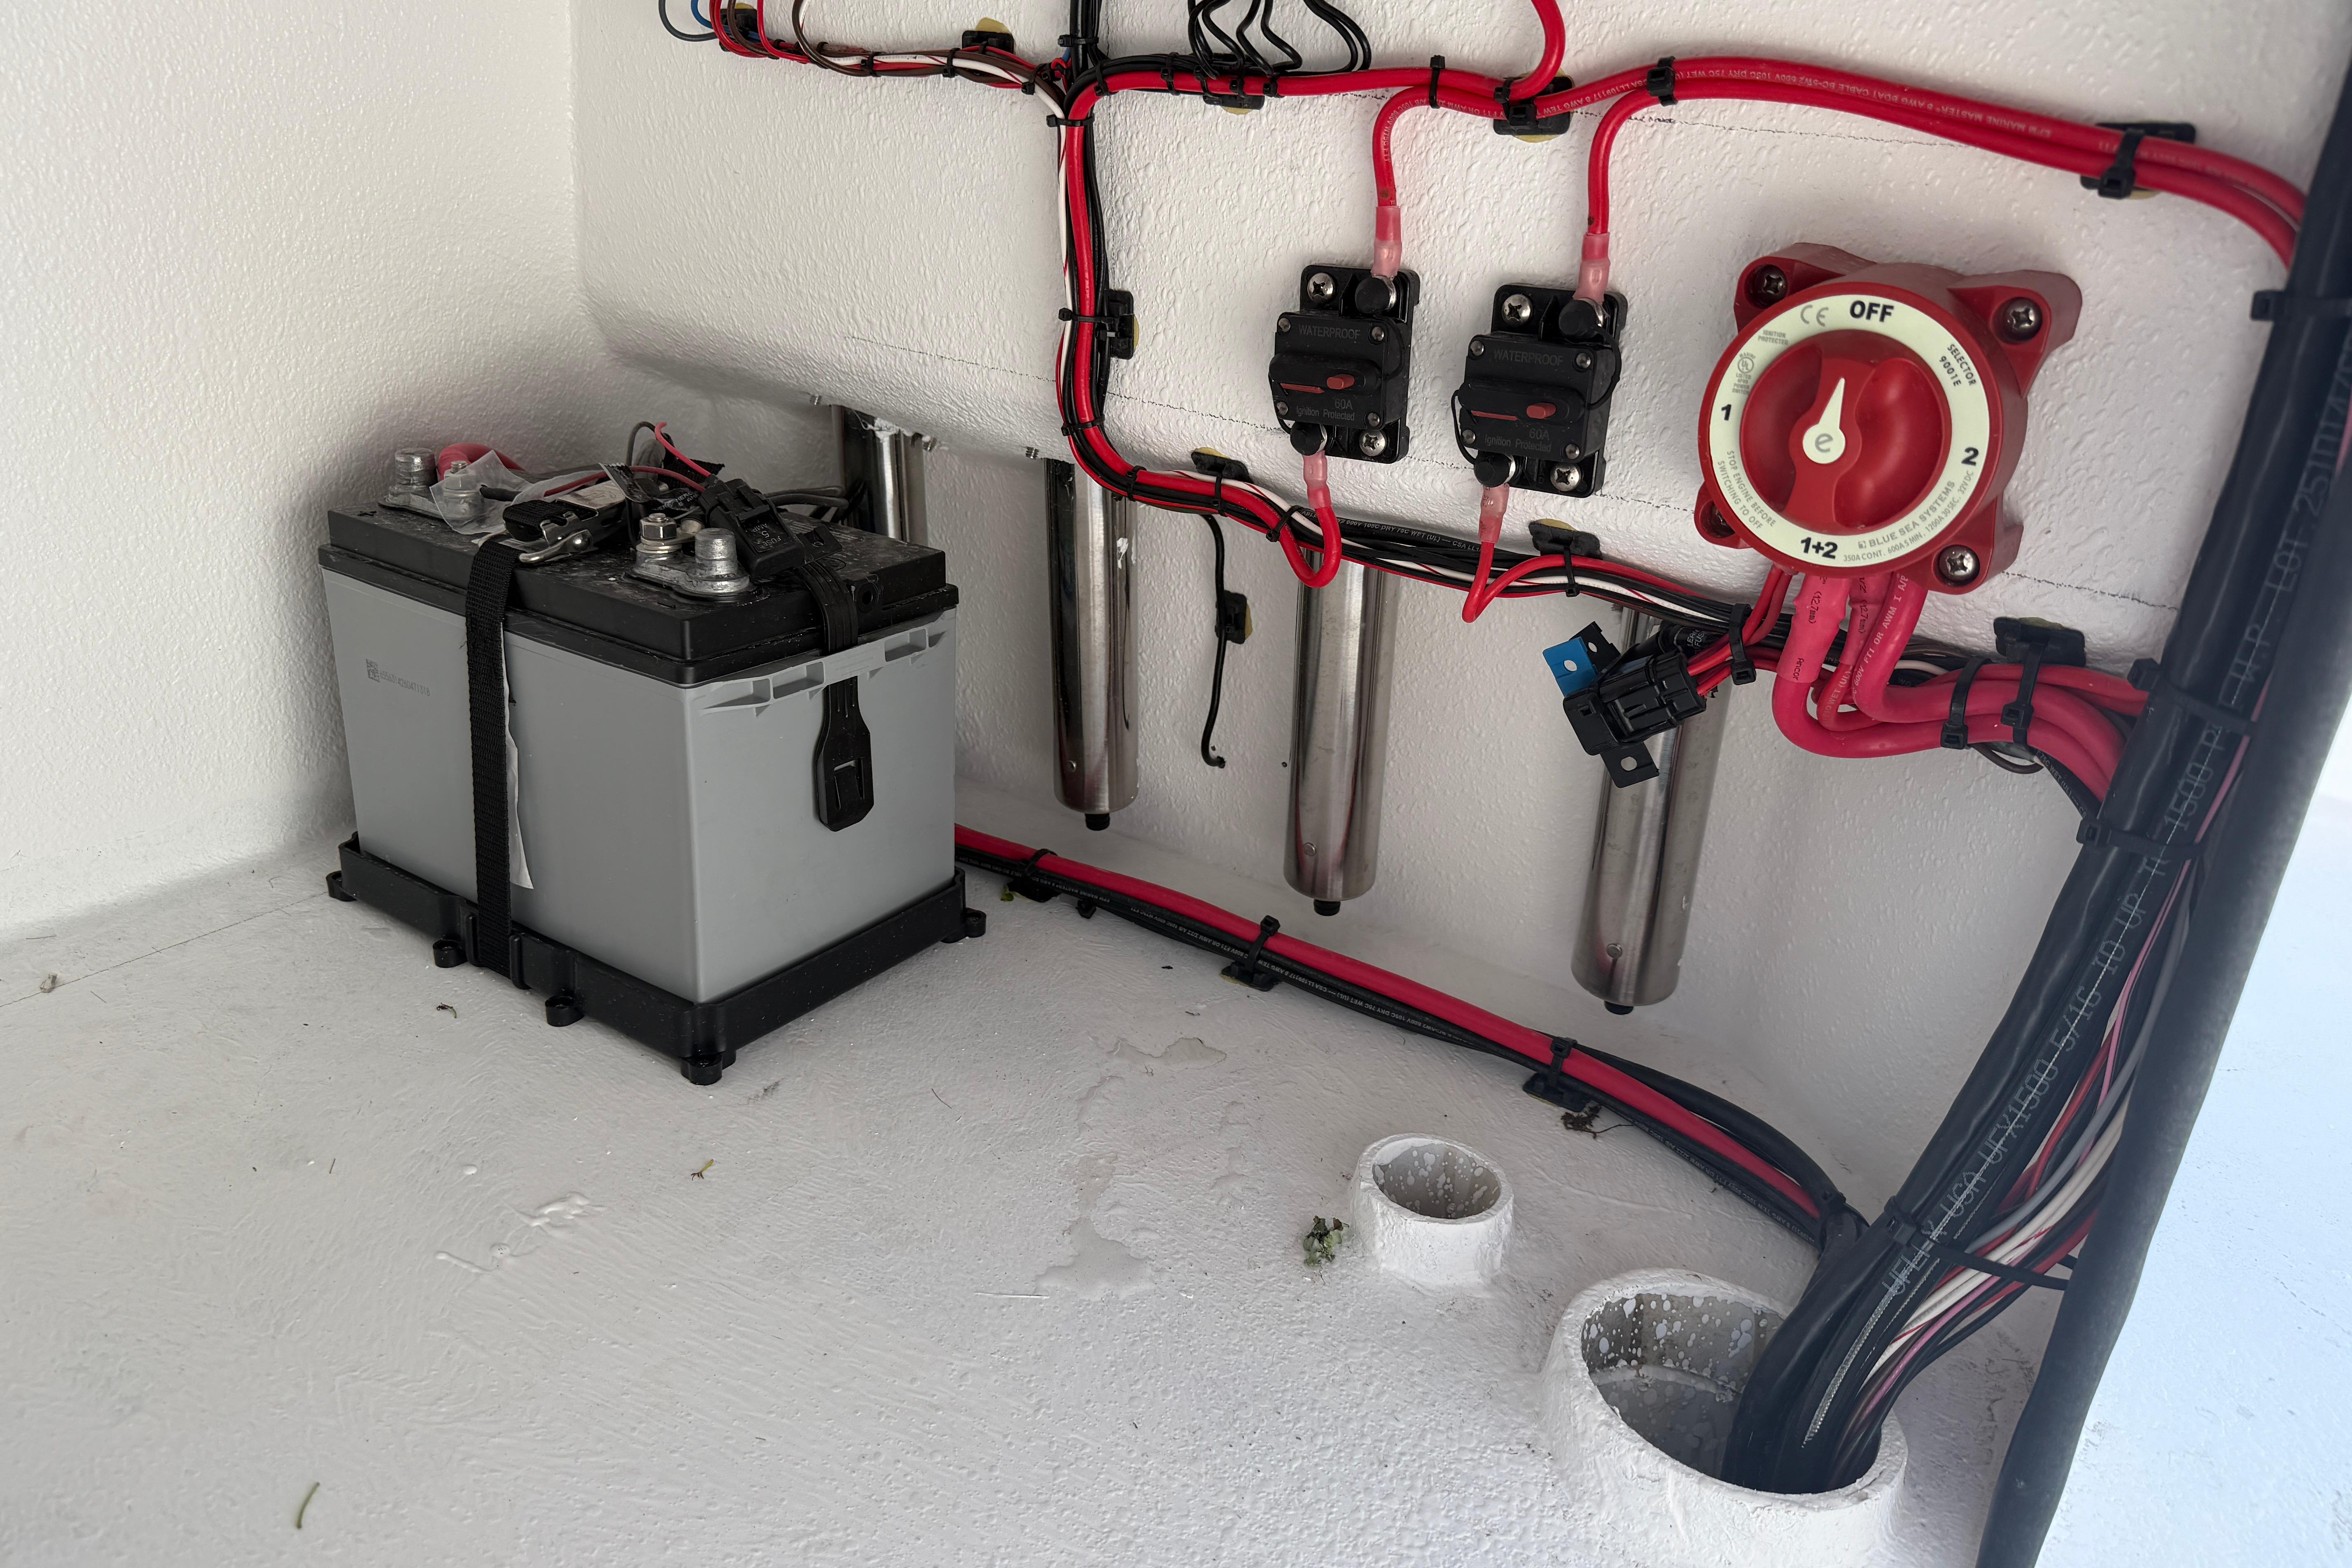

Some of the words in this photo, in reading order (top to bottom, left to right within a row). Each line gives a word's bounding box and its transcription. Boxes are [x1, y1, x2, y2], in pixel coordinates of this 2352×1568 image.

[1686, 70, 1706, 79] WET
[1708, 70, 1725, 78] 75C
[1729, 70, 1747, 79] DRY
[1775, 73, 1797, 82] 600V
[1799, 77, 1835, 89] BC-5W2
[1593, 82, 1629, 100] LL109117
[1839, 83, 1869, 96] CABLE
[1873, 91, 1898, 103] BOAT
[1901, 97, 1925, 109] AWG
[1544, 105, 1562, 114] TEW
[1563, 98, 1584, 110] AWG
[1482, 107, 1497, 117] FT1
[1986, 116, 2025, 132] MARINE
[1800, 304, 1829, 327] CE
[1850, 301, 1894, 322] OFF
[1298, 324, 1361, 339] WATERPROOF
[1763, 329, 1786, 338] IGNITION
[1757, 336, 1788, 345] PROTECTED
[1493, 349, 1564, 366] WATERPROOF
[1947, 344, 1977, 386] SELECTOR
[1939, 356, 1962, 387] 9001E
[1334, 398, 1353, 411] 60A
[1296, 406, 1319, 418] Ignition
[1323, 408, 1355, 421] Protected
[1721, 404, 1732, 421] 1
[1529, 428, 1550, 441] 60A
[1484, 434, 1511, 447] Ignition
[1515, 438, 1552, 452] Protected
[1960, 447, 1979, 466] 2
[1727, 450, 1738, 471] STOP
[1733, 472, 1753, 502] ENGINE
[1750, 502, 1776, 527] BEFORE
[1718, 460, 1741, 505] SWITCHING
[1739, 504, 1750, 516] TO
[1748, 515, 1764, 530] OFF
[1869, 532, 1896, 548] BLUE
[1898, 520, 1920, 536] SEA
[1919, 480, 1955, 522] SYSTEMS
[762, 535, 782, 547] FUSE
[1410, 530, 1426, 539] WET
[1426, 534, 1441, 542] (UL)
[1843, 554, 1861, 563] 350A
[1887, 542, 1905, 554] 600A
[1925, 515, 1945, 532] 1200A
[1942, 508, 1951, 518] 30
[1800, 537, 1838, 559] 1+2
[1854, 665, 1864, 686] 600V
[1863, 647, 1875, 664] FT1
[1873, 632, 1884, 645] OR
[1882, 605, 1897, 629] AWM
[1792, 657, 1805, 681] Ancor
[1827, 688, 1841, 705] WET
[1838, 671, 1852, 687] (UL)
[2050, 764, 2062, 782] WET
[2061, 780, 2072, 797] (UL)
[1939, 1170, 1987, 1218] USA
[1977, 1058, 2060, 1165] UFX1500
[2049, 985, 2102, 1052] 5/16
[2090, 940, 2128, 975] ID
[2117, 892, 2149, 931] UP
[2164, 761, 2214, 833] 1500
[2264, 528, 2310, 594] LOT
[1079, 890, 1099, 900] MARINE
[1199, 934, 1213, 944] AWM
[1220, 943, 1231, 952] FT1
[1230, 948, 1244, 957] 600V
[1257, 959, 1271, 968] TEW
[1270, 965, 1285, 975] AWG
[1289, 973, 1315, 987] LL109117
[1315, 983, 1328, 992] CSA
[1337, 992, 1350, 1002] (UL)
[1349, 997, 1364, 1007] WET
[1377, 1007, 1391, 1016] DRY
[1391, 1012, 1406, 1021] 105C
[1406, 1017, 1422, 1027] 600V
